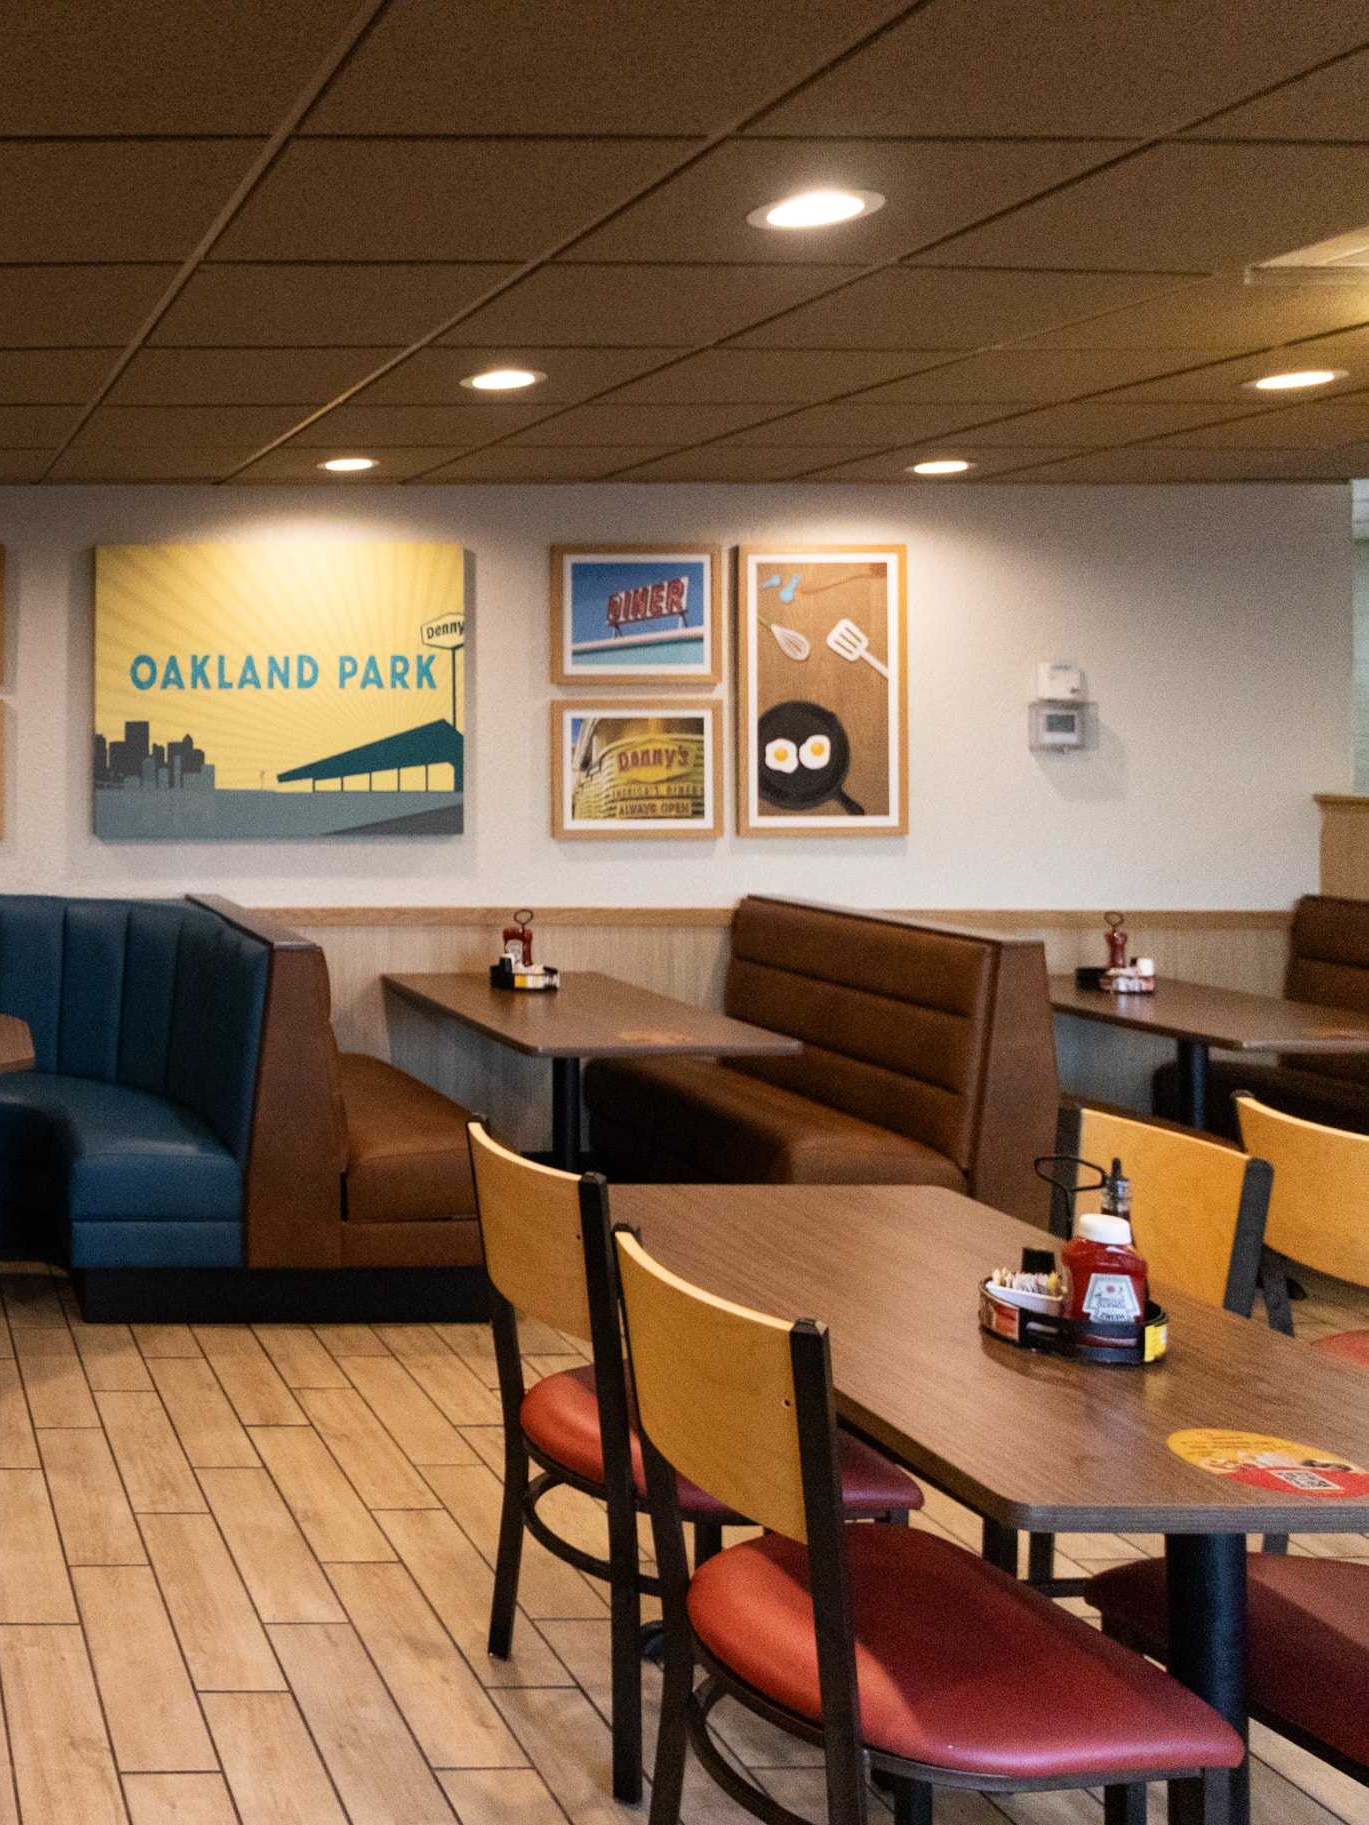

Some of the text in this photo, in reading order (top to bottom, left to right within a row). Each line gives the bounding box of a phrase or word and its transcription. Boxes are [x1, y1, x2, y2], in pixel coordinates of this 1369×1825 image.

[606, 579, 684, 628] DINER
[130, 653, 438, 692] OAKLAND PARK
[617, 744, 689, 772] Denny's
[618, 802, 690, 816] ALWAYS OPEN
